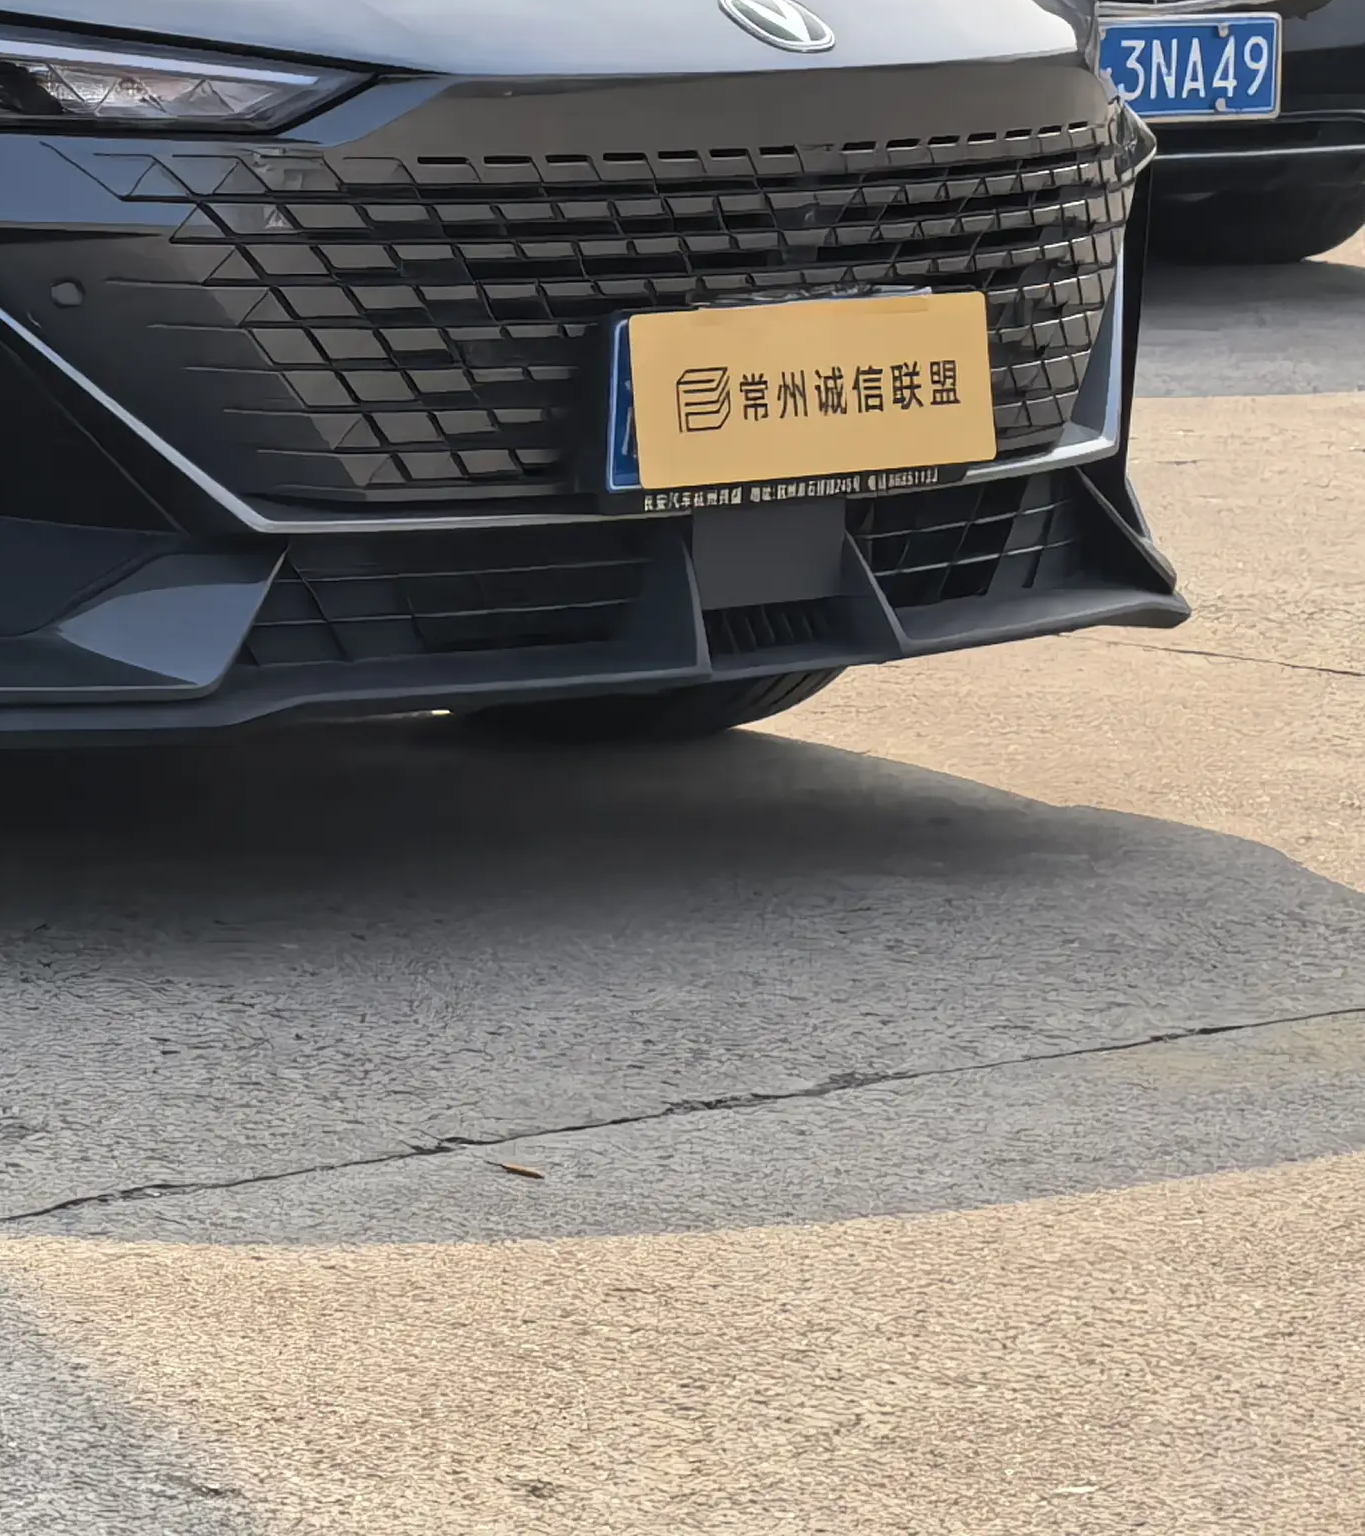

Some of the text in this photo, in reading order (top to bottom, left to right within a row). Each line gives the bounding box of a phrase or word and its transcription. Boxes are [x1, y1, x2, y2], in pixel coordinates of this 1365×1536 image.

[1118, 35, 1269, 102] 3NA49
[739, 360, 961, 421] 常州诚信联盟
